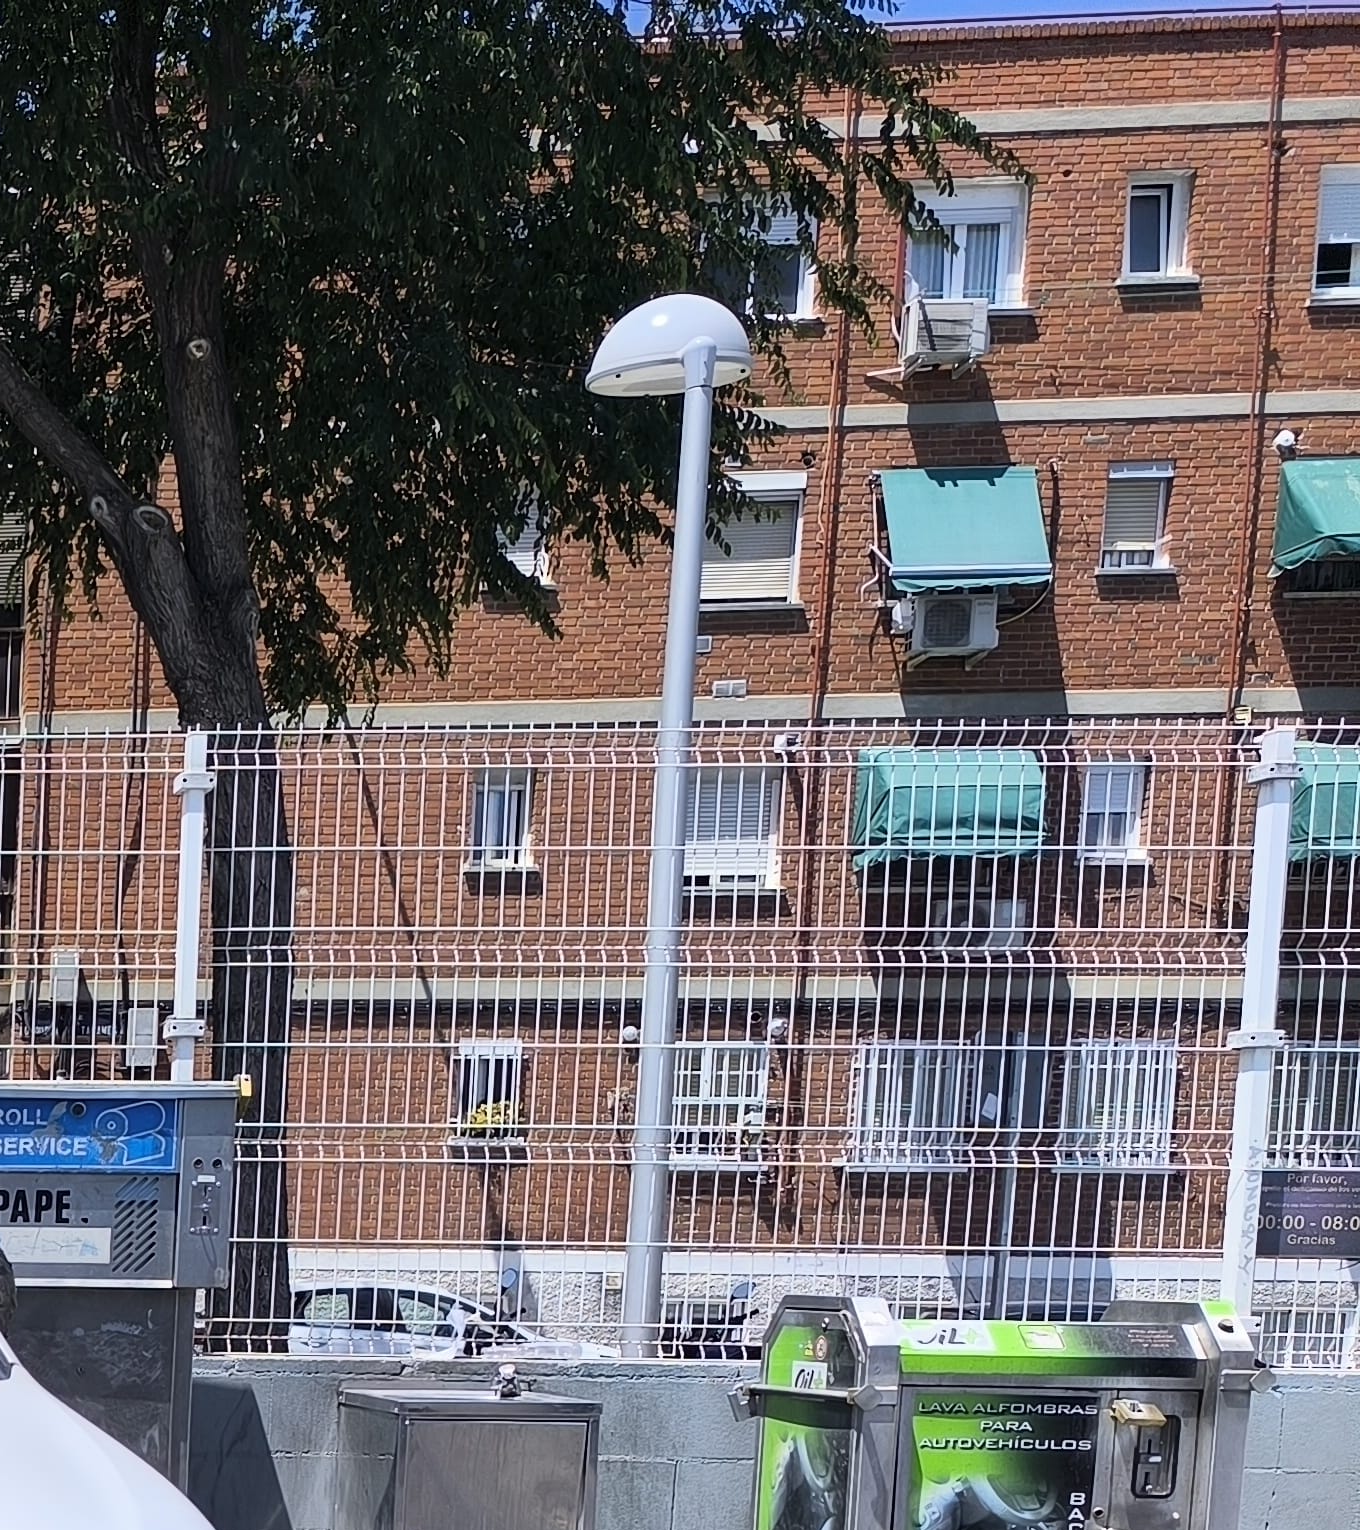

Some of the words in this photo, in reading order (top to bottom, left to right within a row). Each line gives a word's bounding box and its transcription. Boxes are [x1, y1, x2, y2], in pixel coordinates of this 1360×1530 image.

[1287, 1234, 1336, 1245] Gracias
[919, 1402, 966, 1413] LAVA
[975, 1402, 1098, 1415] ALFOMBRAS
[981, 1421, 1032, 1432] PARA
[918, 1435, 1092, 1450] AUTOVEHÍCULOS
